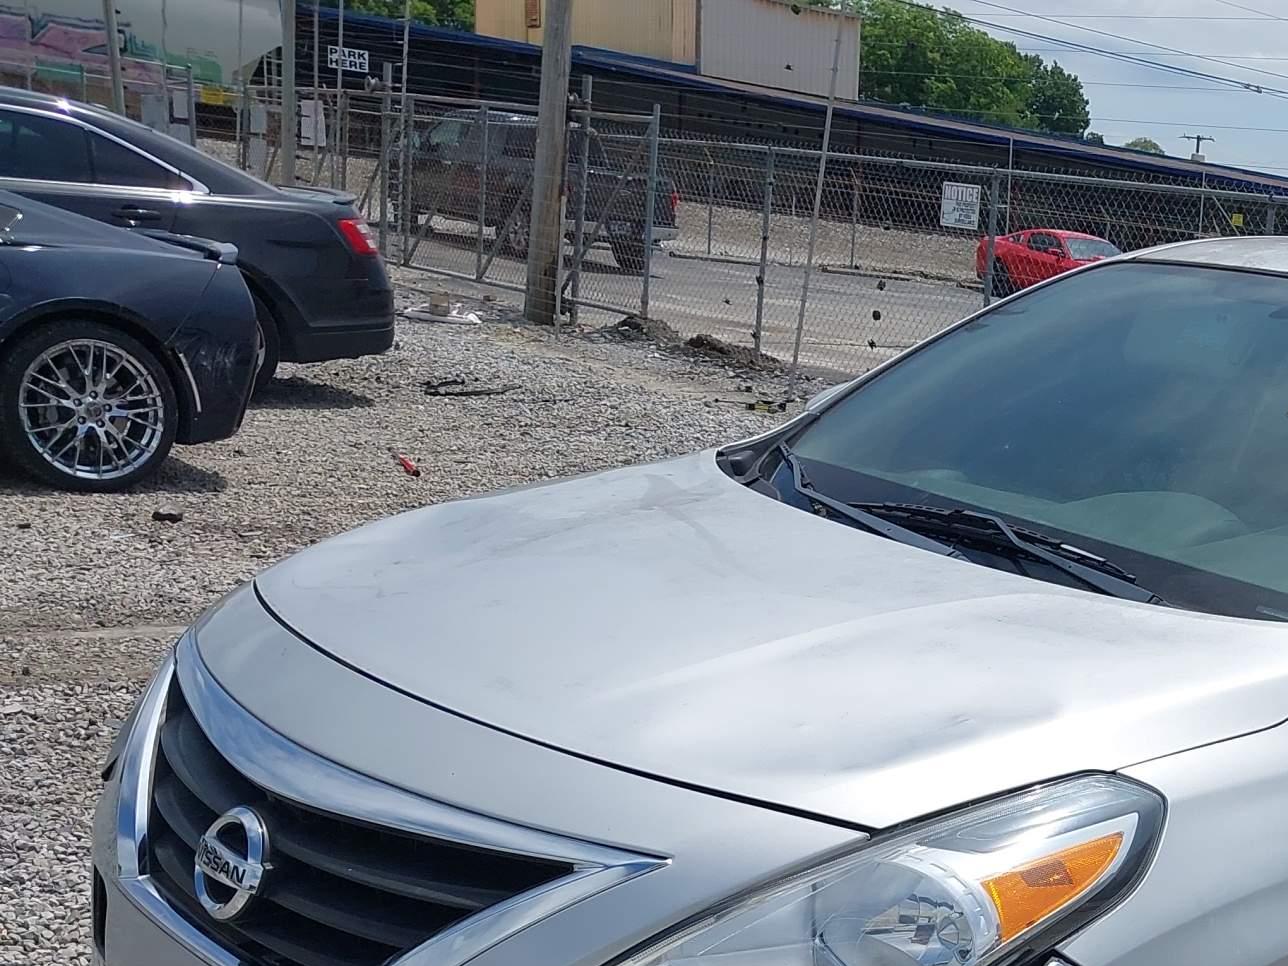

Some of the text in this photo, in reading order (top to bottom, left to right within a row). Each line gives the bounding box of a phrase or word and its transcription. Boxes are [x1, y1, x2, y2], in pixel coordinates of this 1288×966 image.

[329, 57, 367, 70] HERE
[944, 184, 979, 202] NOTICE
[197, 842, 247, 884] NISSAN
